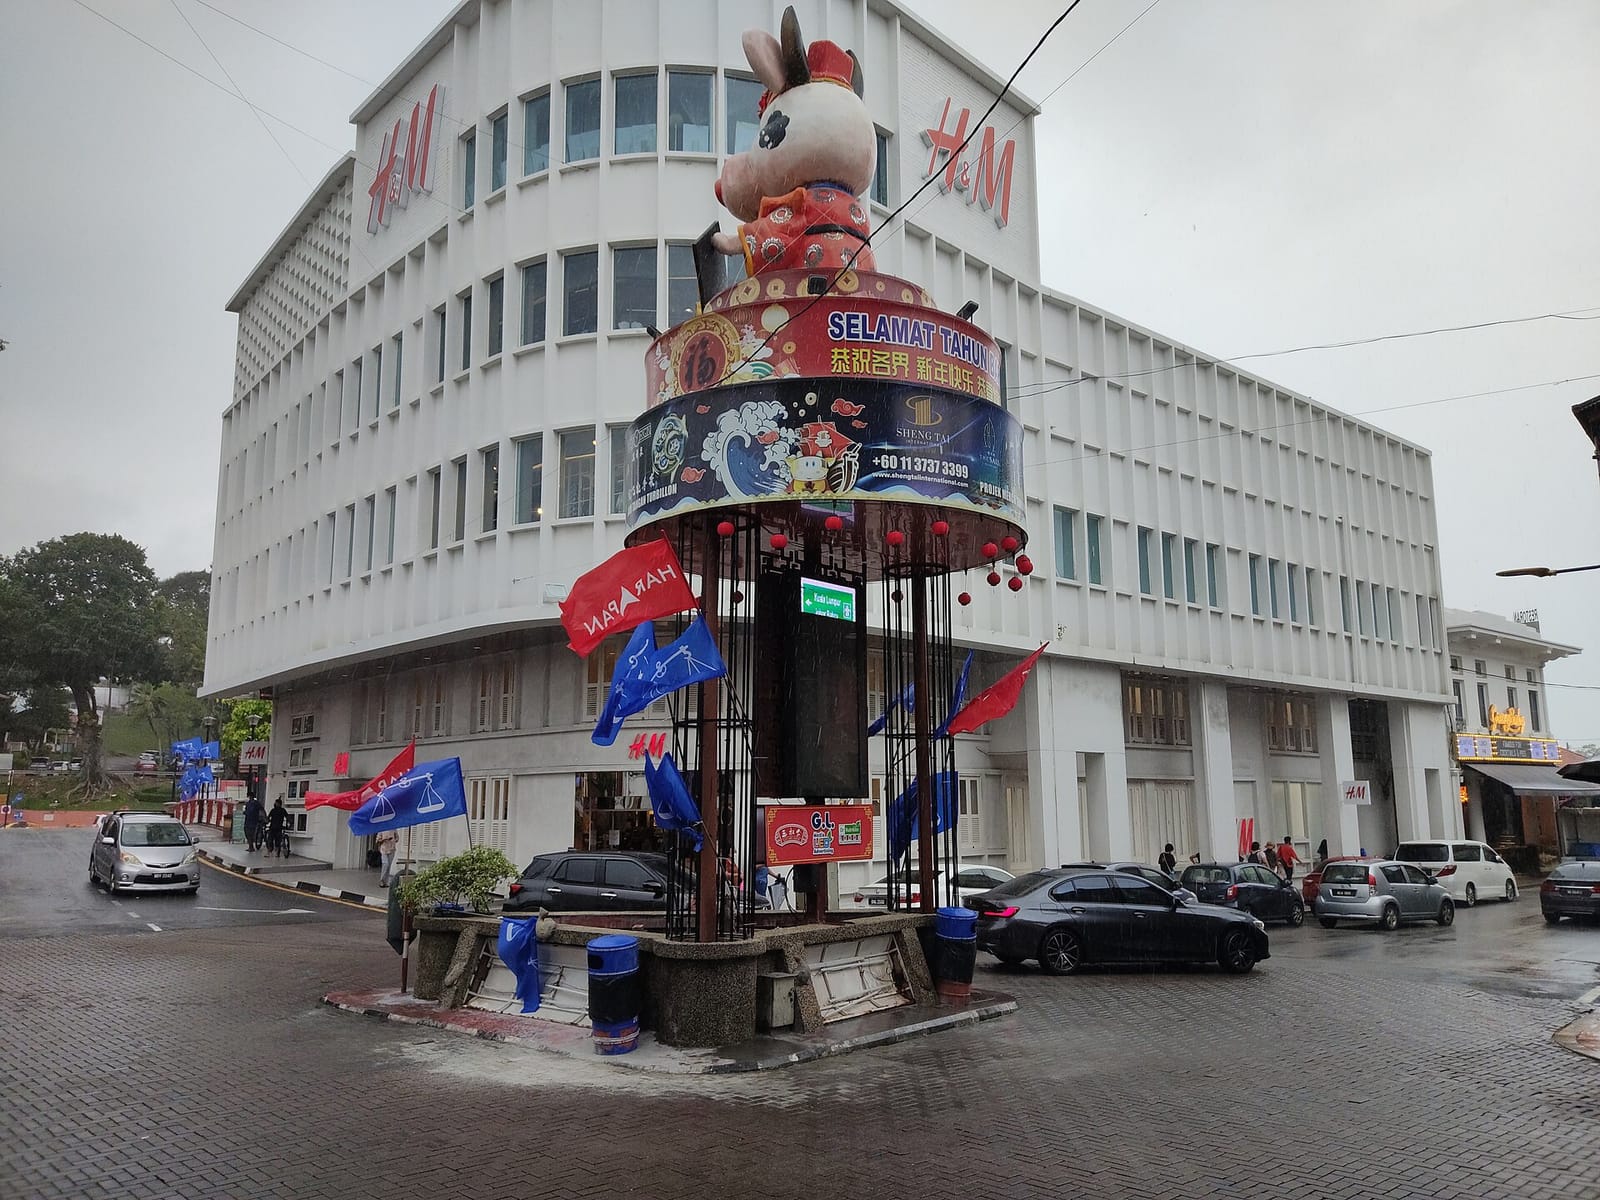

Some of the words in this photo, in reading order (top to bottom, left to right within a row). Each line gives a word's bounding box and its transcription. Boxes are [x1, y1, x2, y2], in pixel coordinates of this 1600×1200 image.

[367, 84, 438, 234] H&M
[925, 97, 1016, 226] H&M
[828, 311, 936, 350] SELAMAT
[939, 325, 988, 371] TAHUN
[831, 347, 909, 378] 恭祝各界
[916, 355, 974, 395] 新年快乐
[896, 427, 932, 441] SHENG
[934, 432, 950, 444] TAI
[872, 454, 897, 469] +60
[900, 456, 912, 471] 11
[914, 457, 940, 474] 3737
[942, 461, 968, 479] 3399
[811, 811, 835, 830] G.L.
